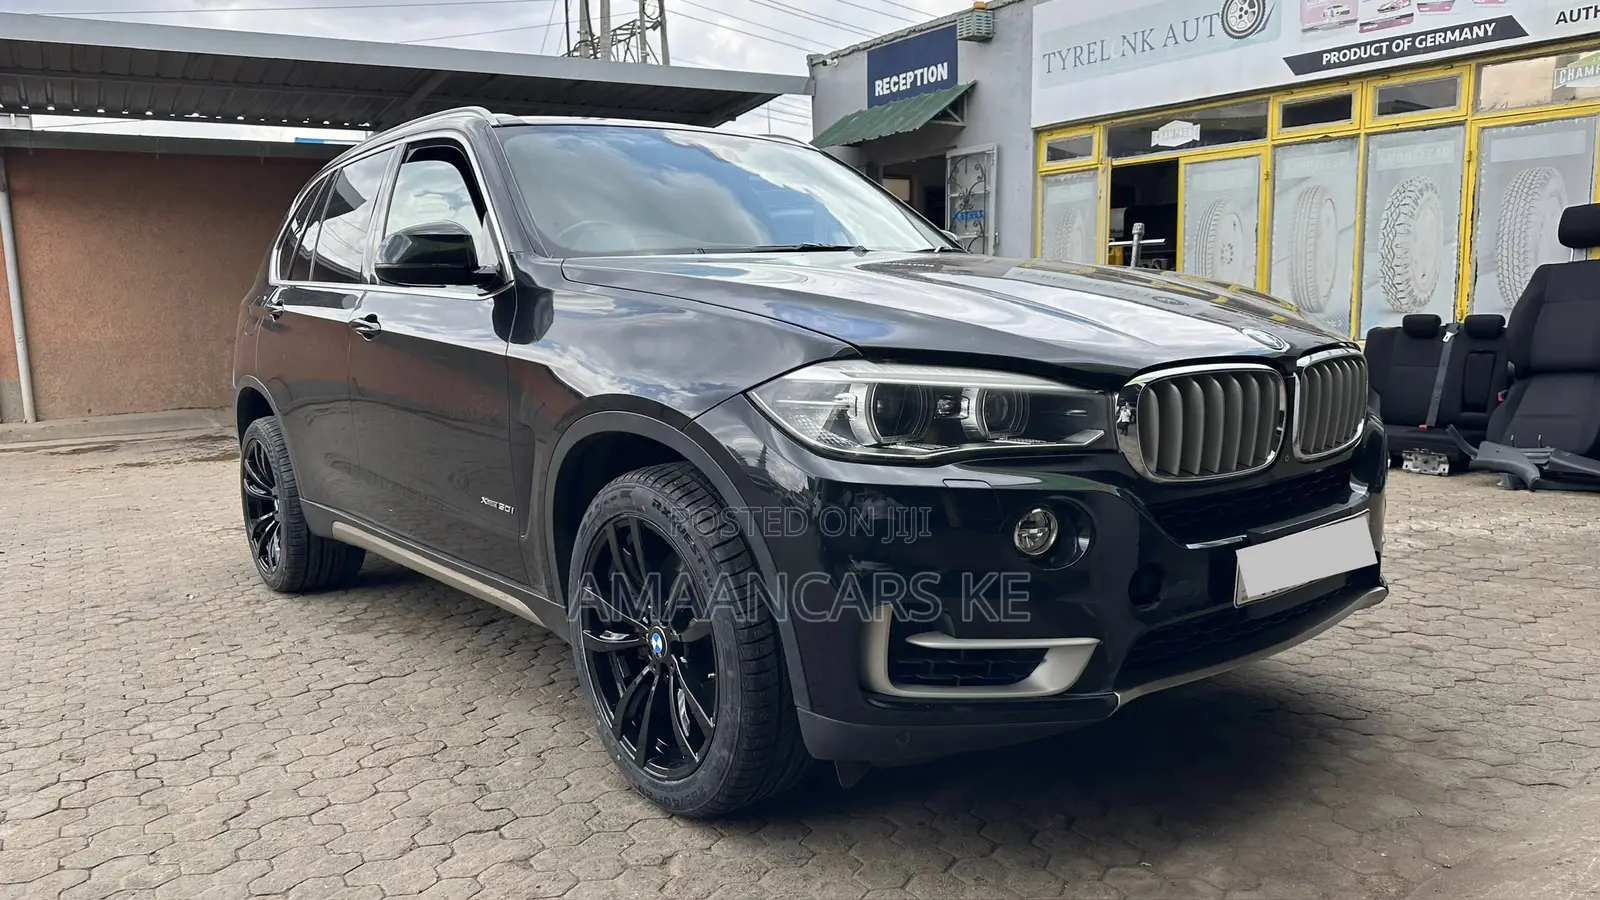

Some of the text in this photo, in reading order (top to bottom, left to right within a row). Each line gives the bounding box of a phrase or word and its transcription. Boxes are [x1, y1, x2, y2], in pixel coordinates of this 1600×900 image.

[1322, 22, 1496, 65] PRODUCT OF GERMANY
[875, 61, 948, 96] RECEPTION
